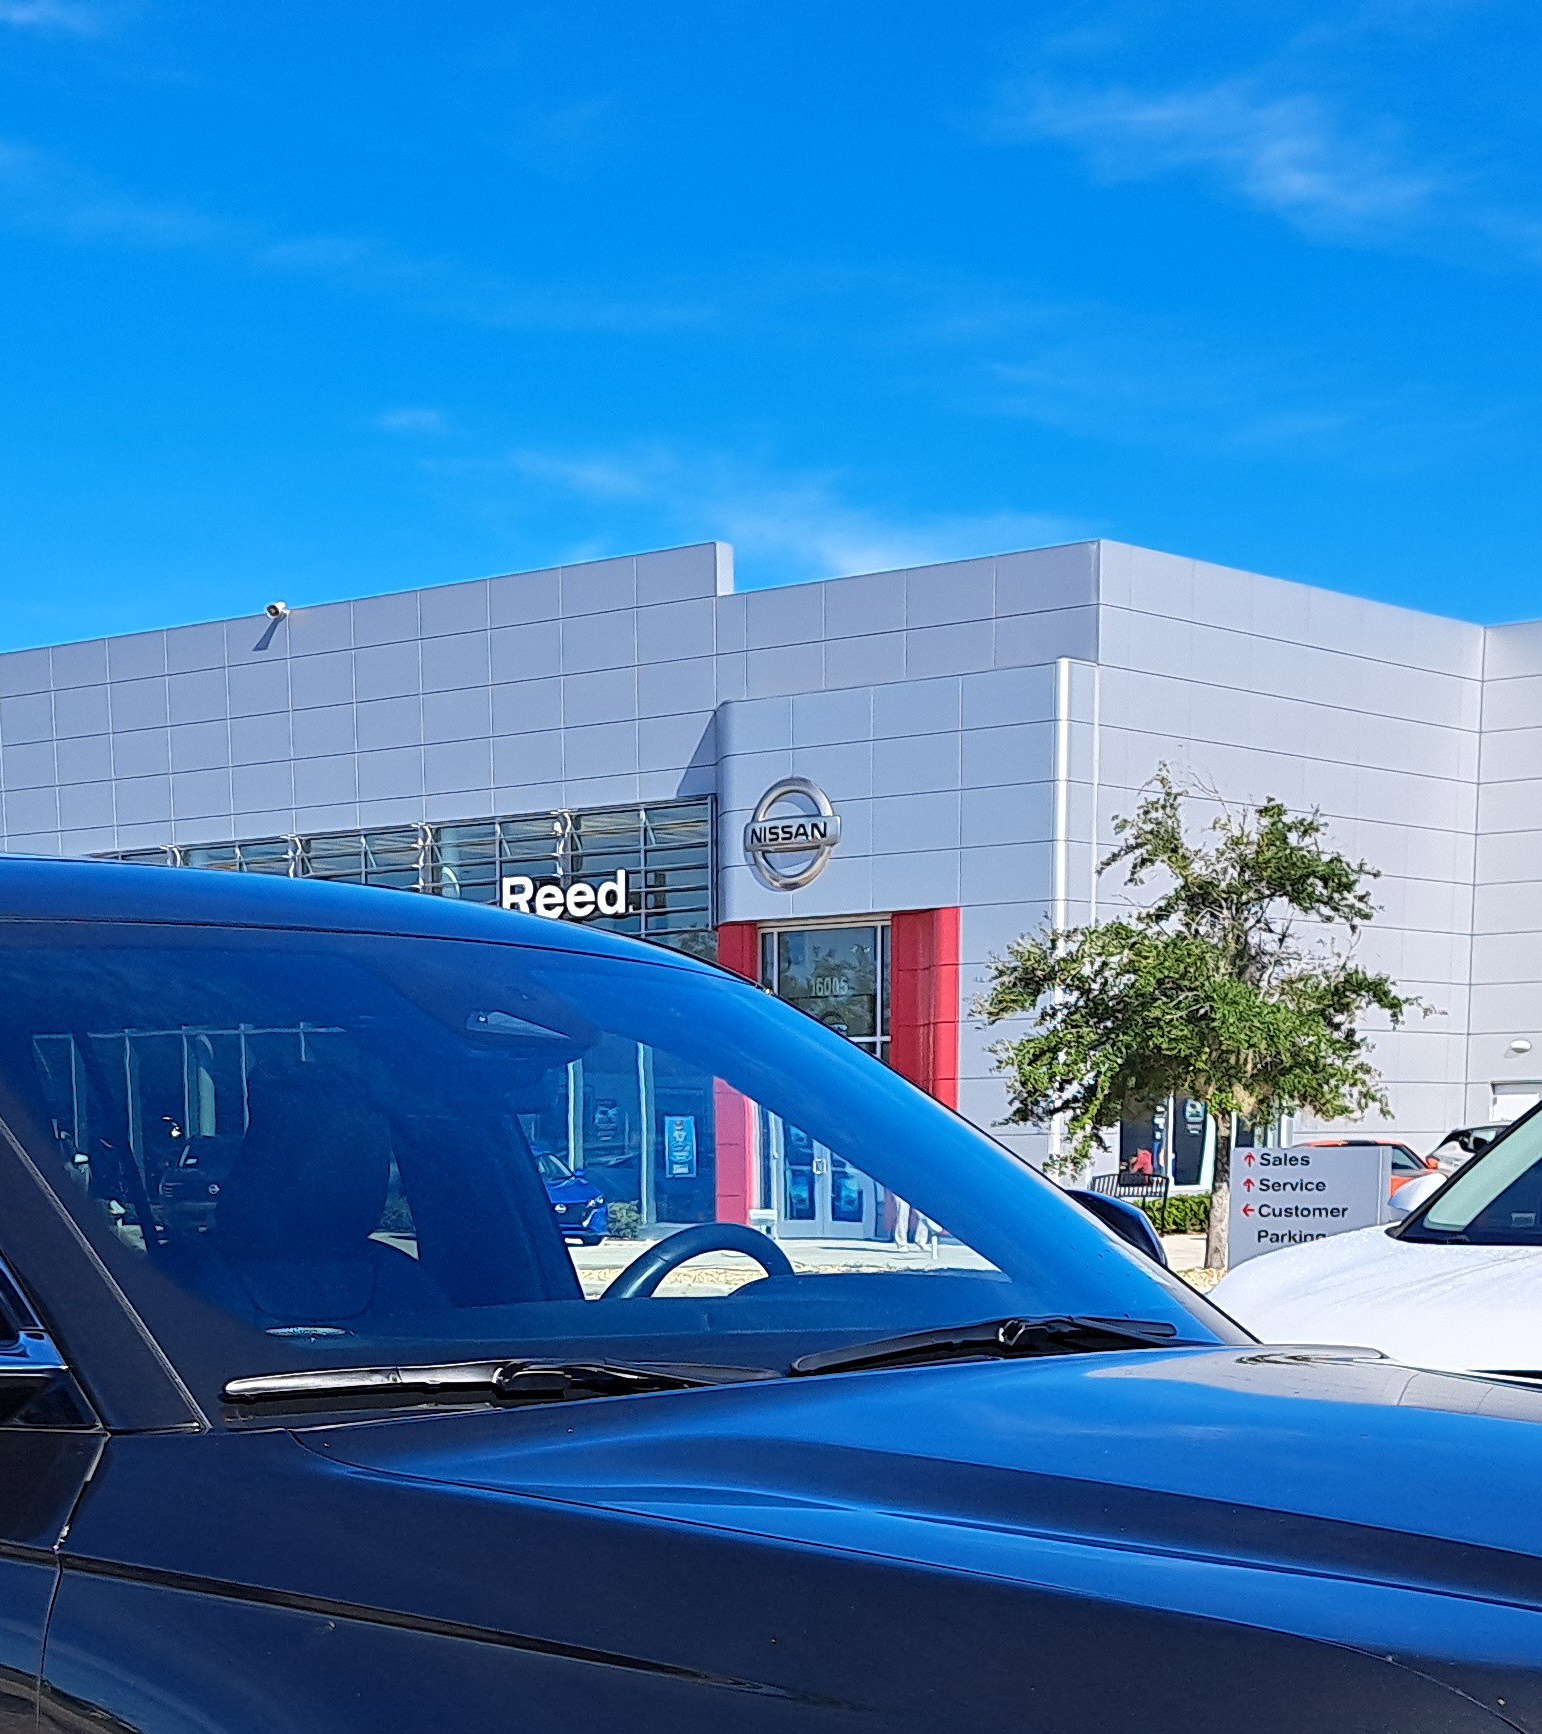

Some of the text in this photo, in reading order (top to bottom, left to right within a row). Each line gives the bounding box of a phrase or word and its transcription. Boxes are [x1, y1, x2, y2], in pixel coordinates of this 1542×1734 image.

[750, 821, 827, 845] NISSAN
[501, 868, 627, 919] Reed
[810, 977, 849, 996] 16005
[1259, 1152, 1311, 1167] Sales
[1259, 1178, 1327, 1193] Service
[1258, 1204, 1349, 1219] Customer
